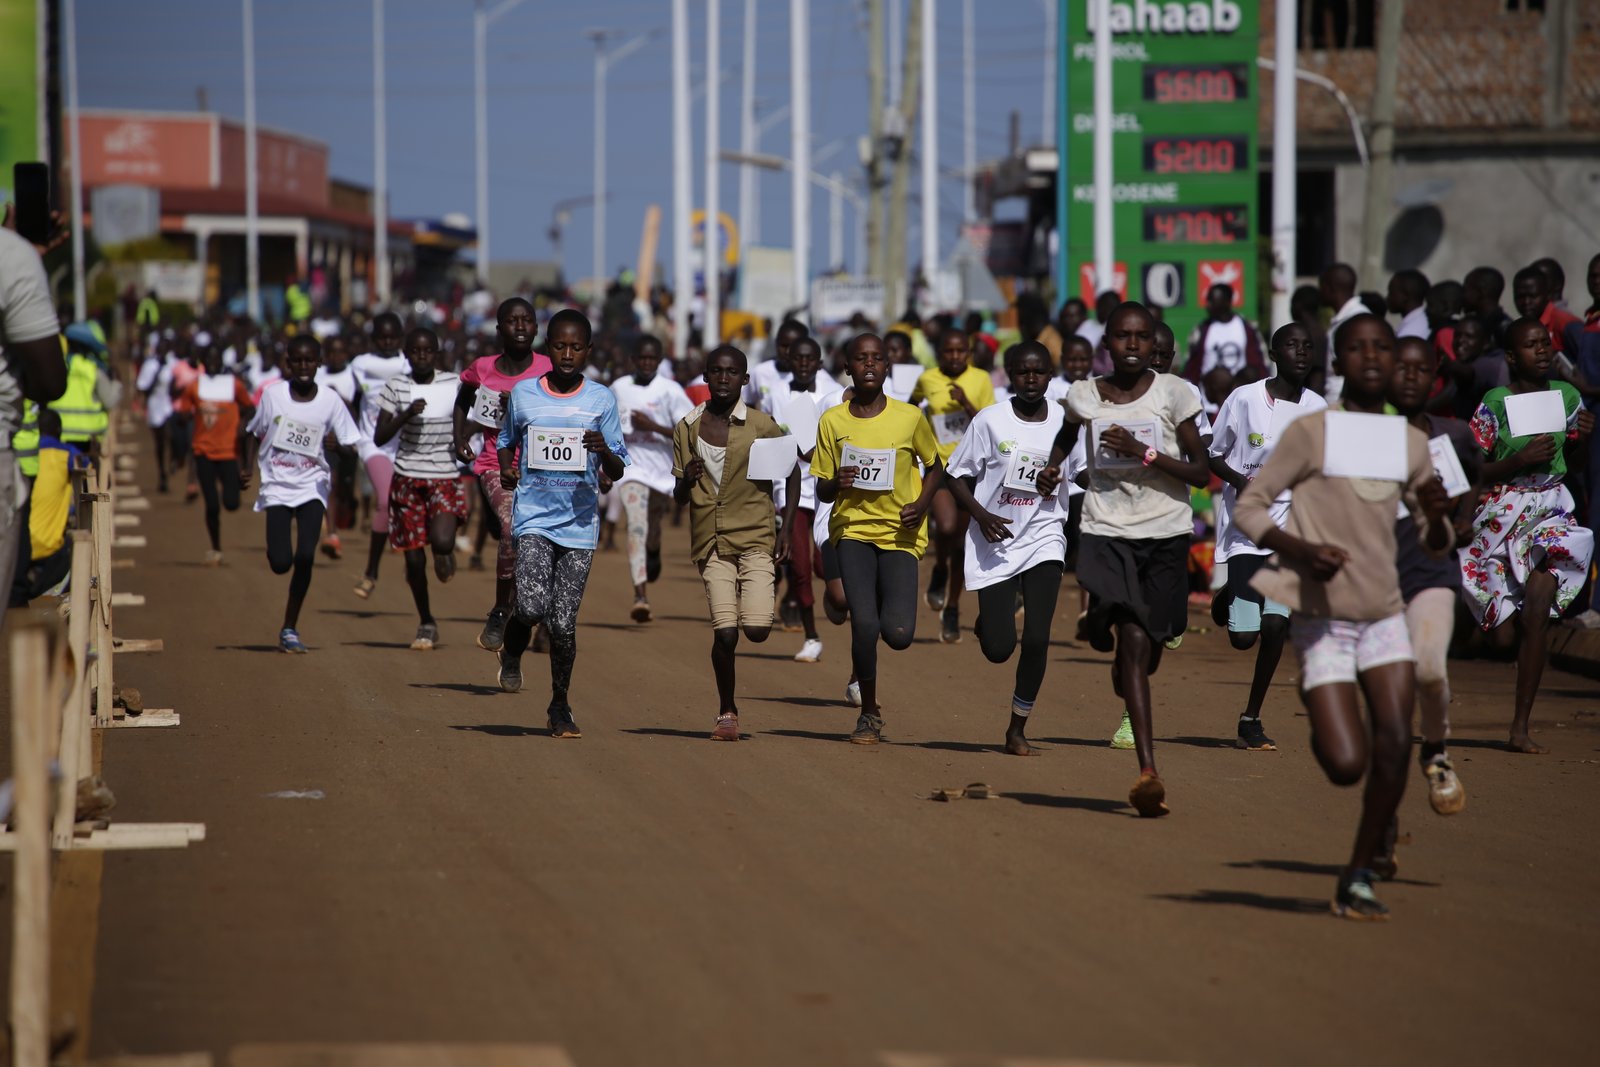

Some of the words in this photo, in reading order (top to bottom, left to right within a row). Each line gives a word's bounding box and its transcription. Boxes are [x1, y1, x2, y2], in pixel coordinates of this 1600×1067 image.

[1073, 42, 1149, 61] PEROL
[1154, 71, 1236, 102] 5600
[1073, 114, 1141, 132] DISEL
[1153, 141, 1235, 174] 5200
[1073, 183, 1178, 203] KEOSENE
[481, 405, 506, 420] 247
[286, 432, 311, 447] 288
[542, 446, 572, 461] 100
[854, 467, 881, 481] 07
[1018, 466, 1037, 482] 14
[997, 492, 1035, 506] Xmas
